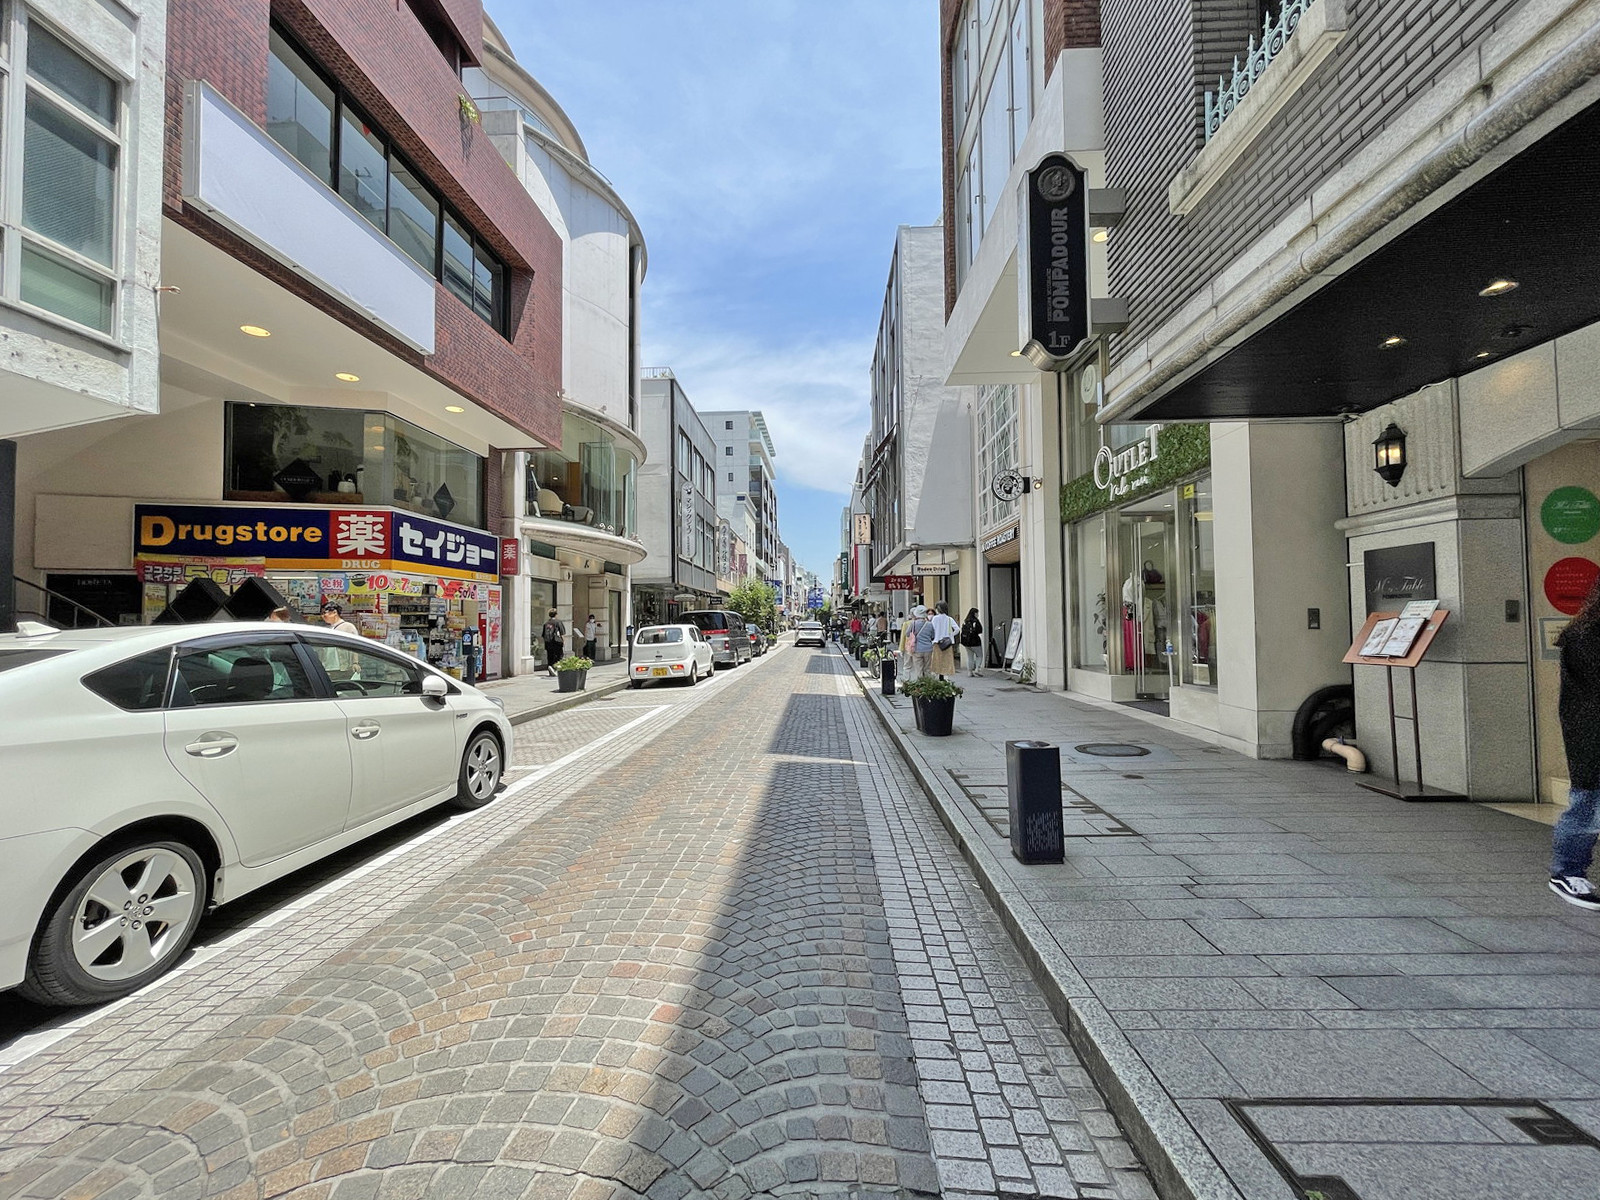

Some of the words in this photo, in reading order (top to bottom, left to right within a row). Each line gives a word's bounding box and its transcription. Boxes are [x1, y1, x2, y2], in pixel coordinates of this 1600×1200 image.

[1051, 207, 1070, 322] POMPADOUR
[1048, 331, 1071, 348] 1F
[1094, 423, 1164, 490] OUTLET
[140, 515, 323, 546] Drugstore
[336, 514, 386, 556] 薬
[399, 522, 496, 566] セイジョー
[503, 544, 517, 560] 薬
[144, 565, 182, 575] ココカラ
[341, 559, 381, 569] DRUG
[321, 578, 344, 589] 免税
[1401, 576, 1424, 592] Table
